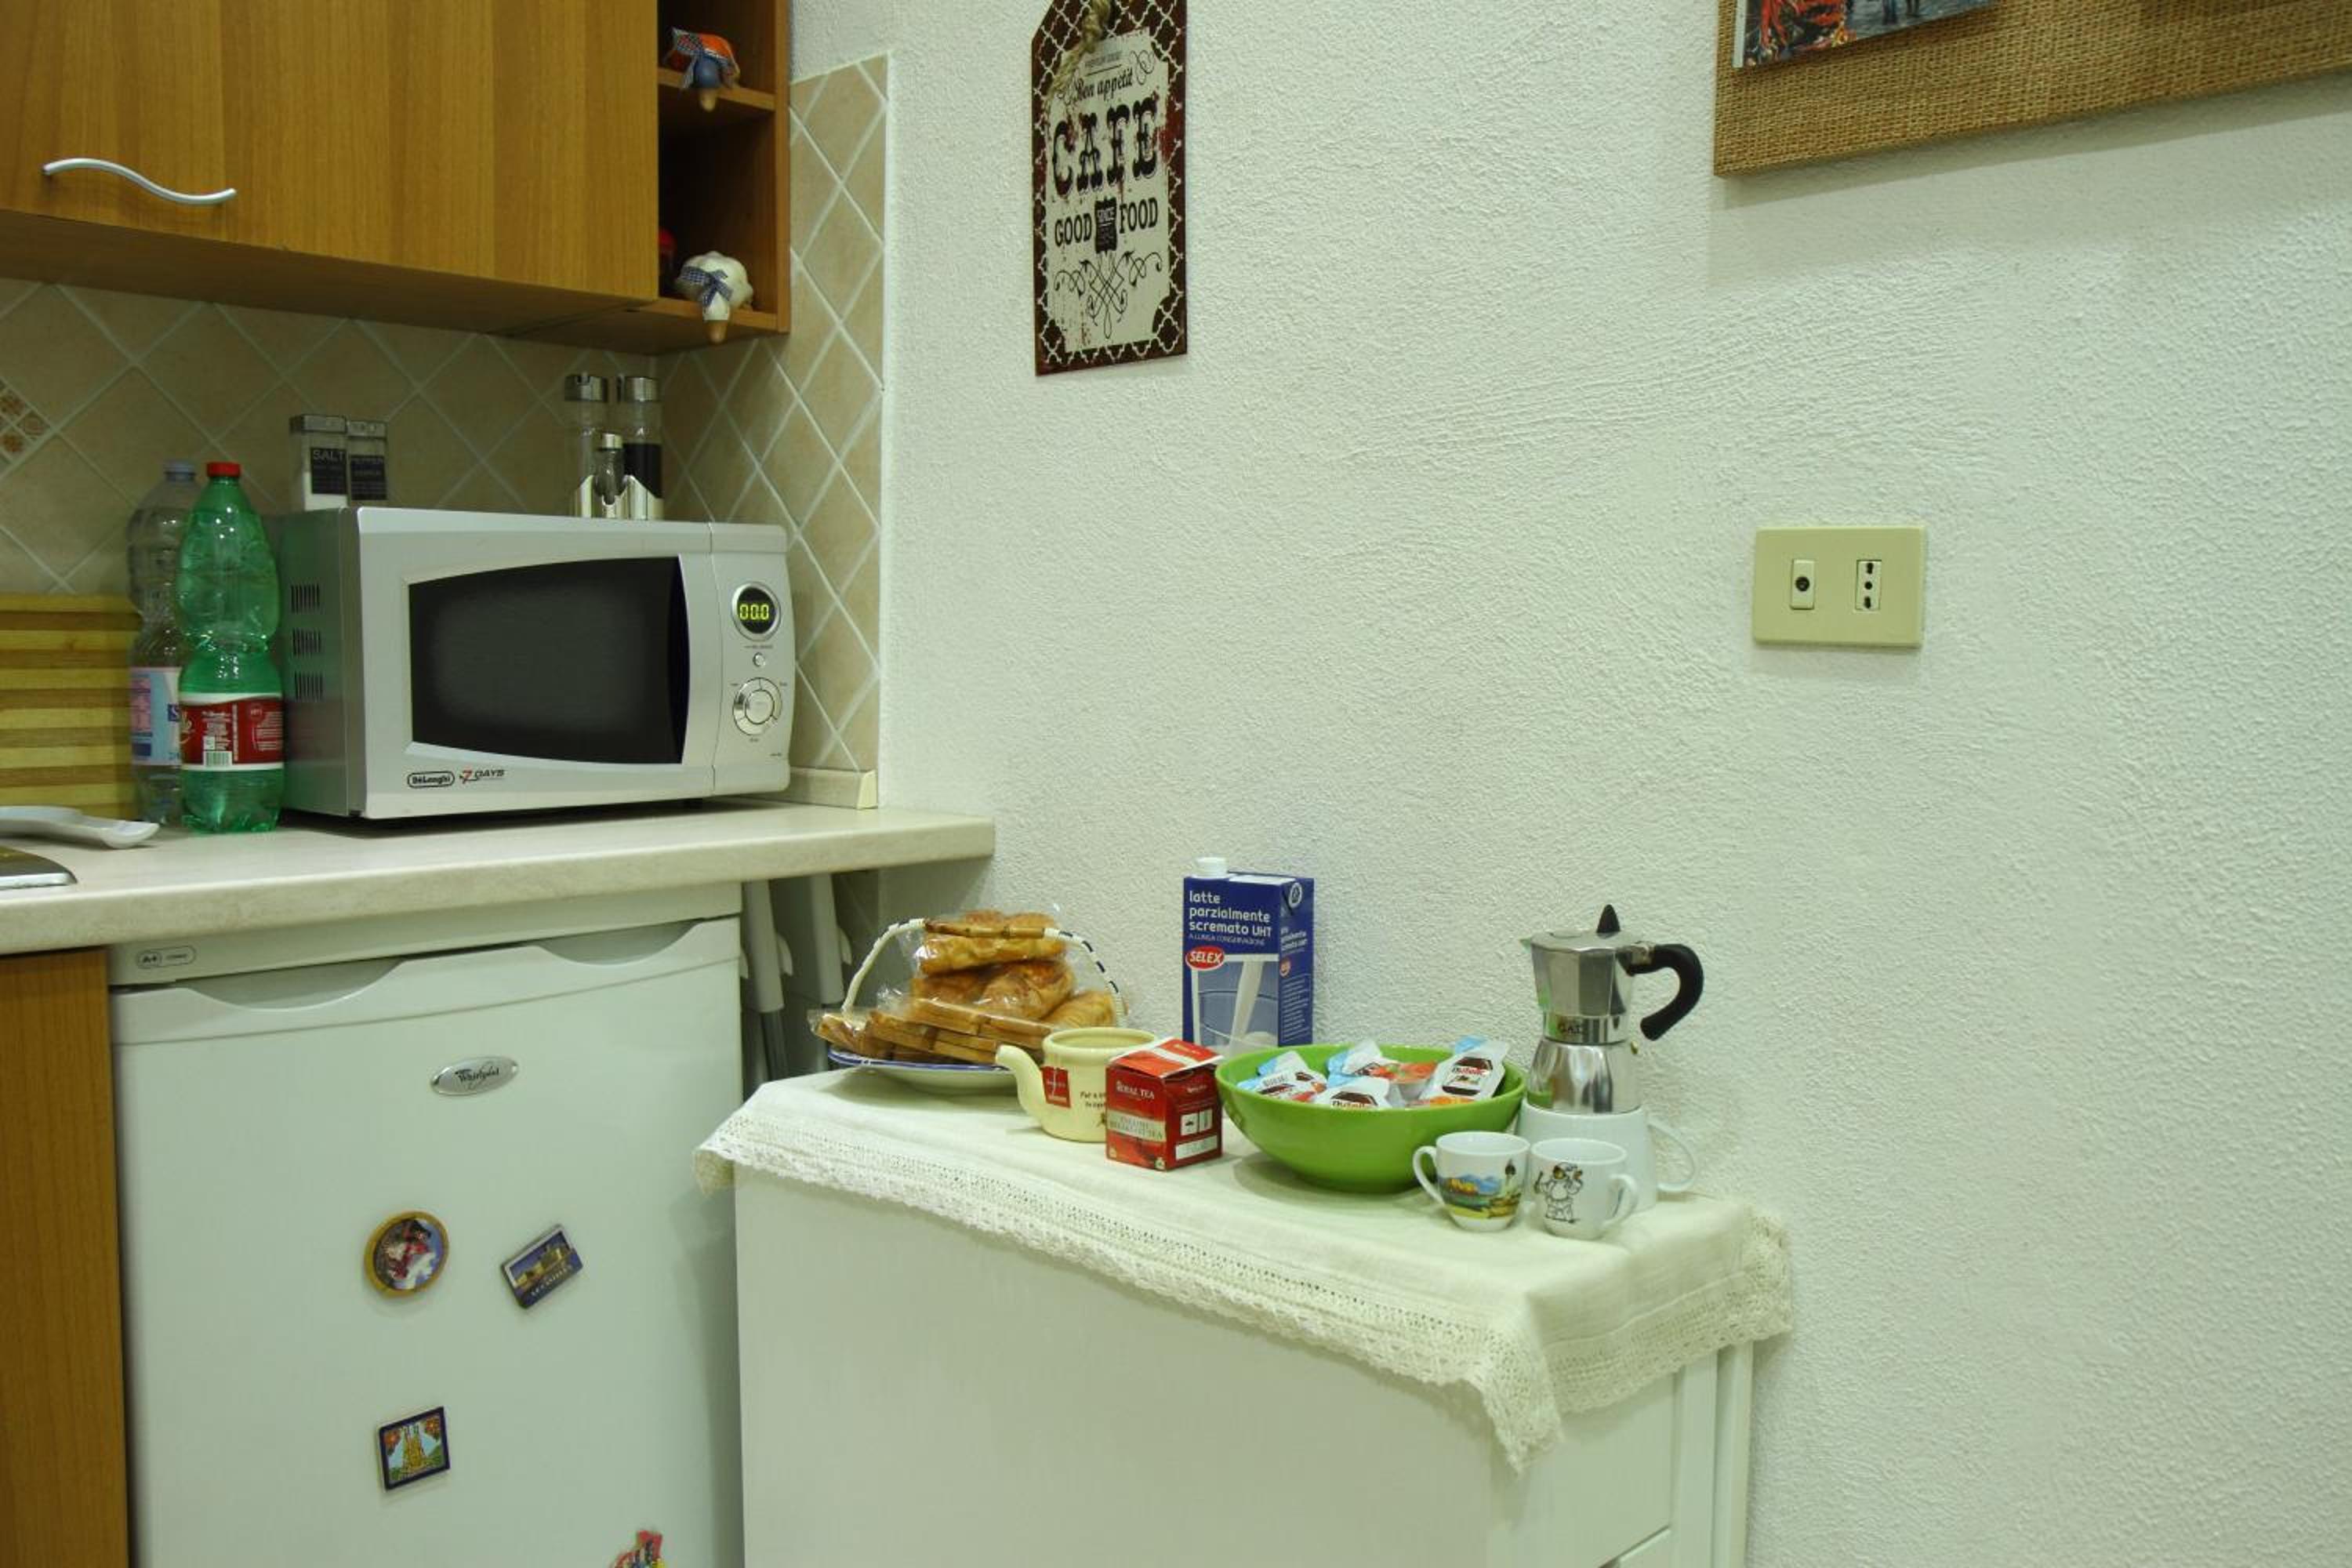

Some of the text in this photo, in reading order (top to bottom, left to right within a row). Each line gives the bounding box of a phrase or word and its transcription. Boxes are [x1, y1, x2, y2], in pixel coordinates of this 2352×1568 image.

[1054, 212, 1092, 247] GOOD
[1119, 197, 1159, 234] FOOD
[1189, 890, 1221, 904] latte
[1189, 907, 1270, 924] parzialmente
[1189, 921, 1272, 938] scremato UHT
[1189, 949, 1222, 964] SELEX
[1140, 1088, 1155, 1100] TEA
